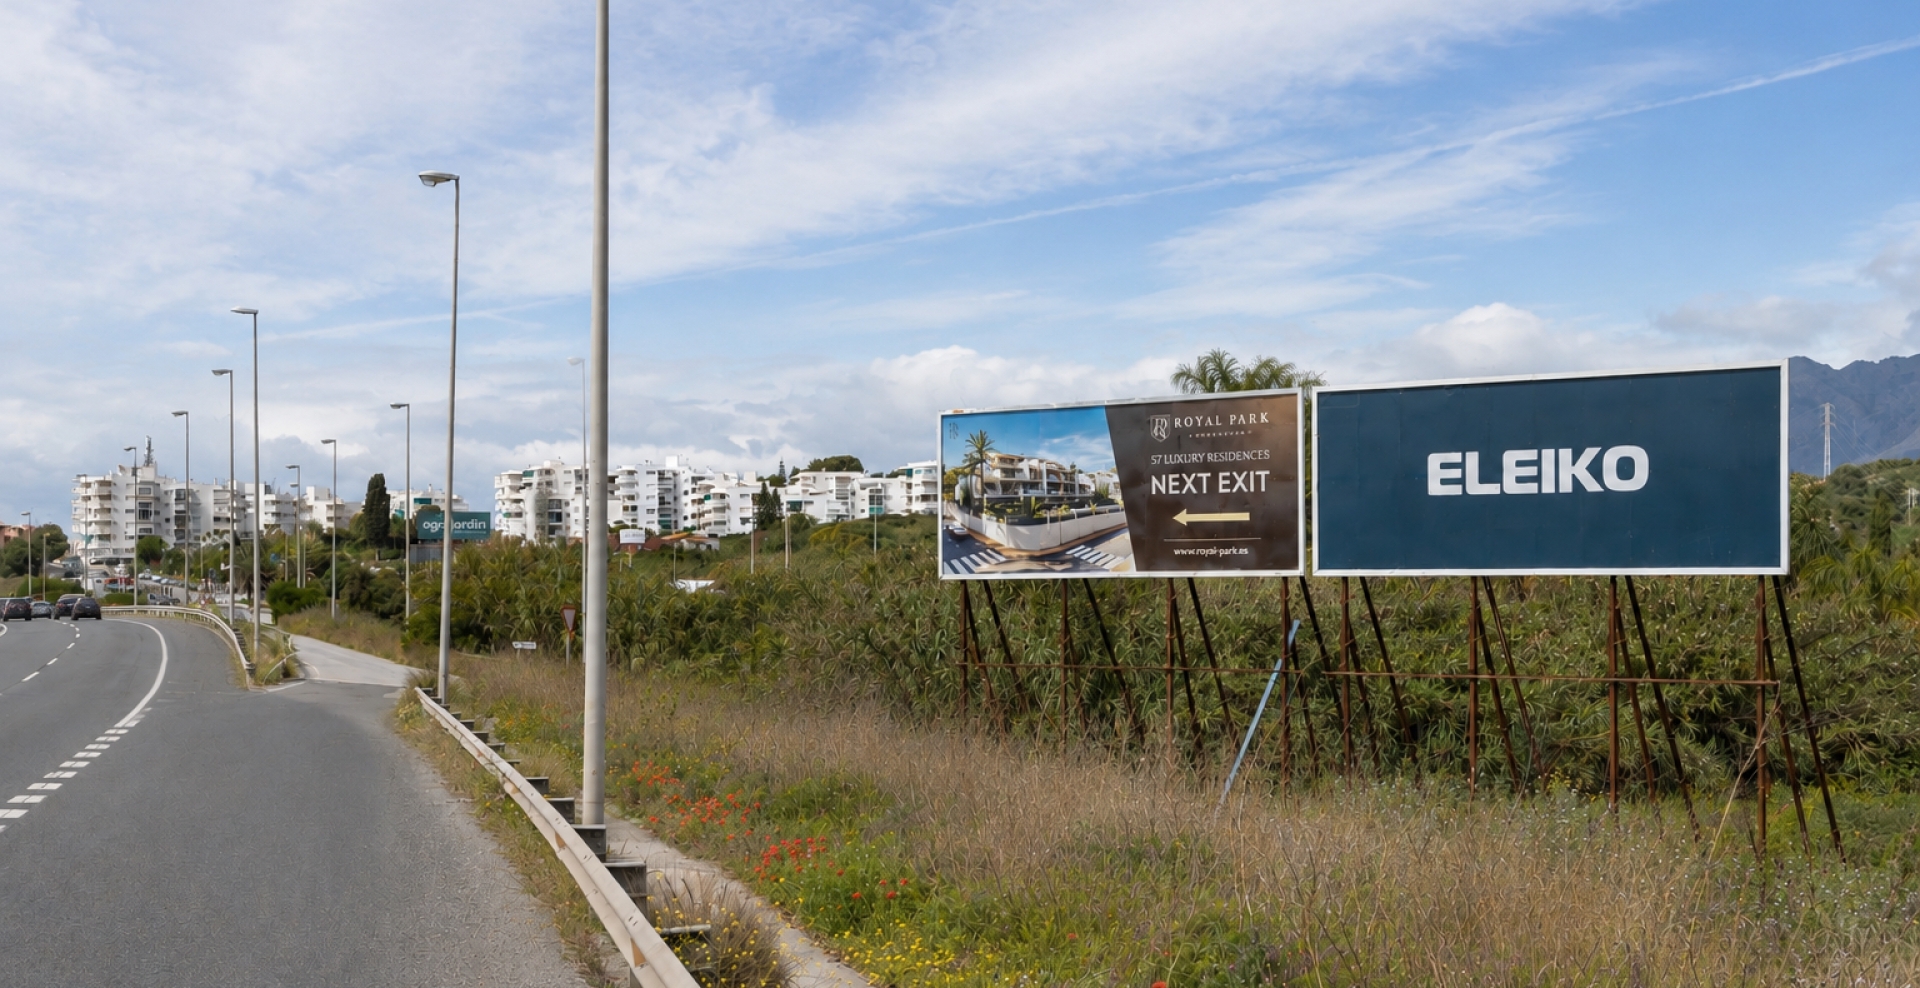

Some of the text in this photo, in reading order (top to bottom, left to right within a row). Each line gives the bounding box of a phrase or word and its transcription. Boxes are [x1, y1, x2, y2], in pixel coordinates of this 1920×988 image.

[1174, 415, 1222, 429] ROYAL
[1229, 412, 1270, 426] PARK
[1151, 449, 1270, 465] 57 LUXURY RESIDENCES
[1427, 445, 1650, 496] ELEIKO
[1151, 470, 1270, 495] NEXT EXIT
